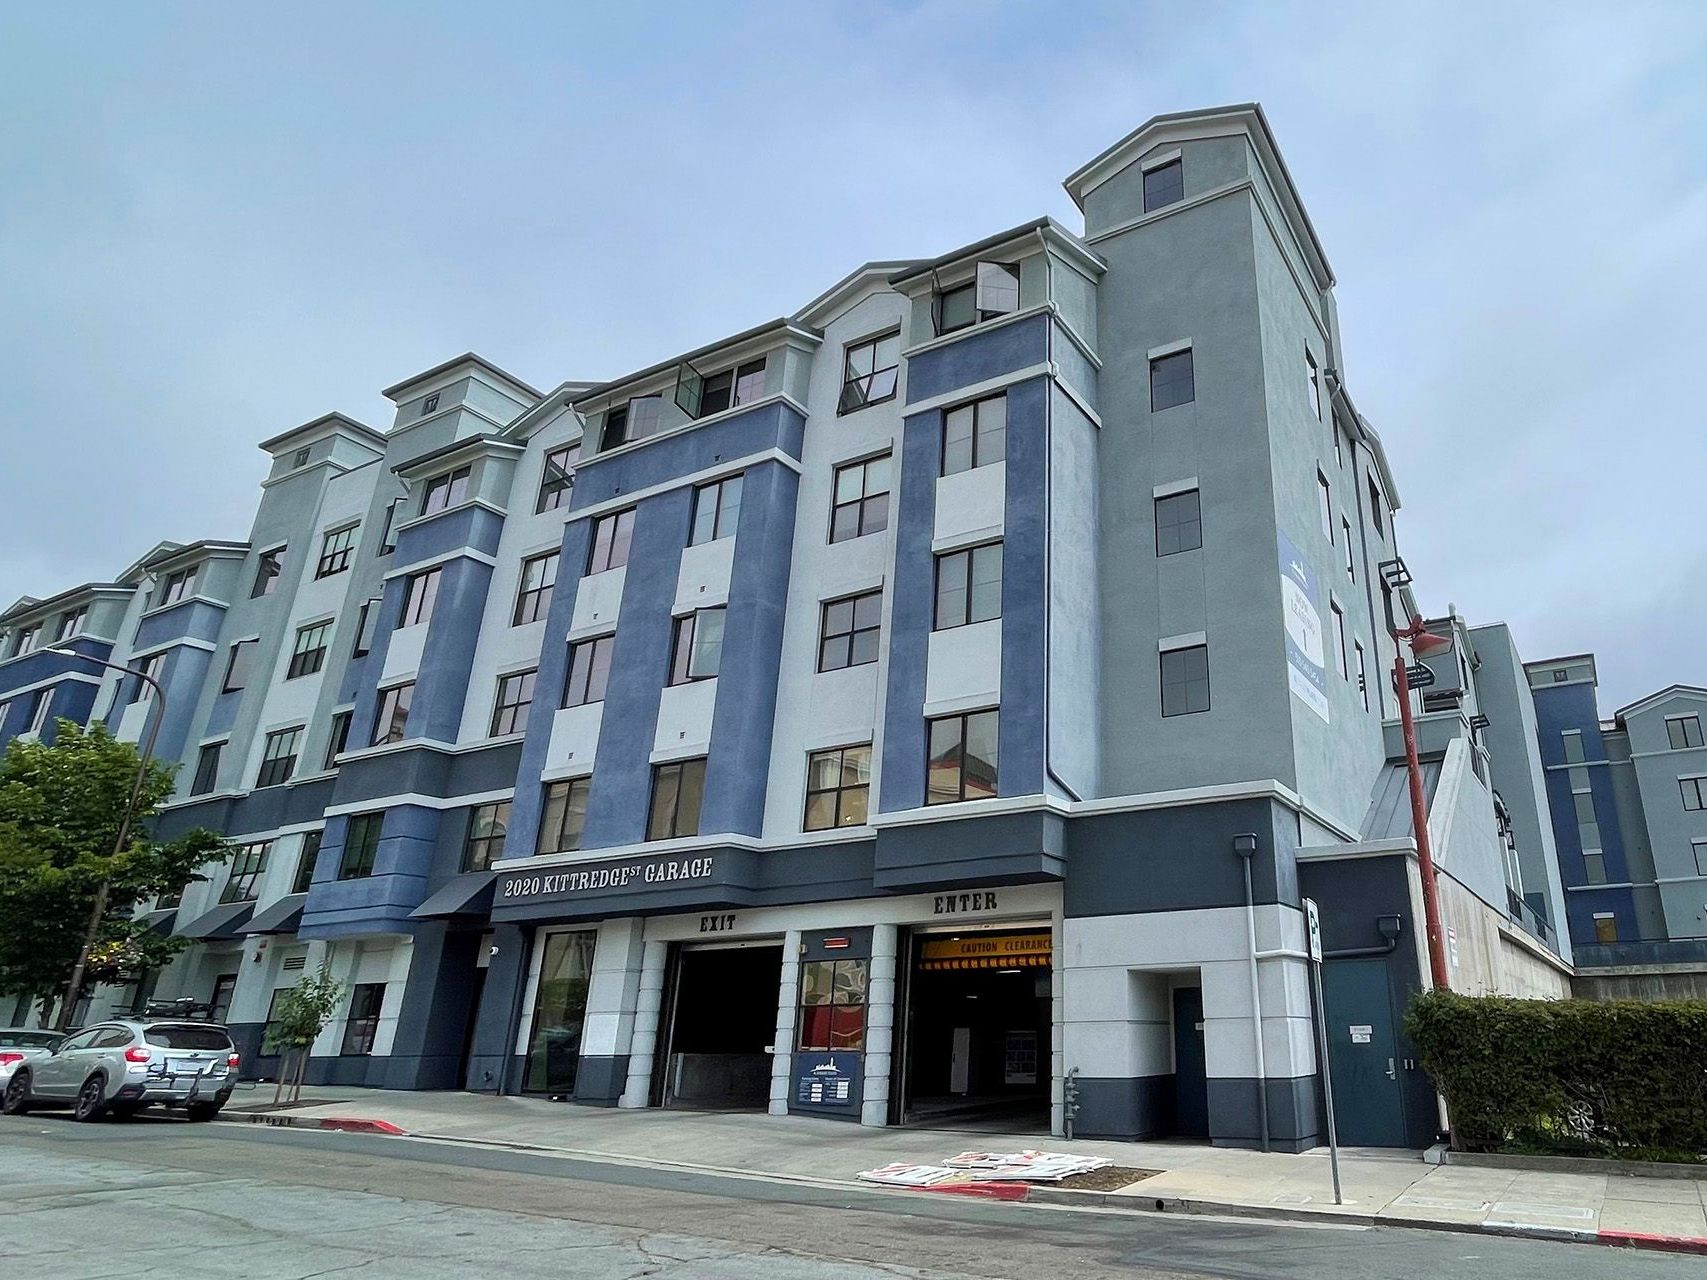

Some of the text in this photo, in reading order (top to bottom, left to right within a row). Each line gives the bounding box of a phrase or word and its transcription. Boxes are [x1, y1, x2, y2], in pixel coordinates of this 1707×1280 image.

[504, 877, 540, 897] 2020
[542, 867, 630, 894] KITTREDGE
[644, 857, 713, 883] GARAGE
[934, 892, 998, 914] ENTER
[700, 915, 736, 932] EXIT
[961, 942, 998, 953] CAUTION
